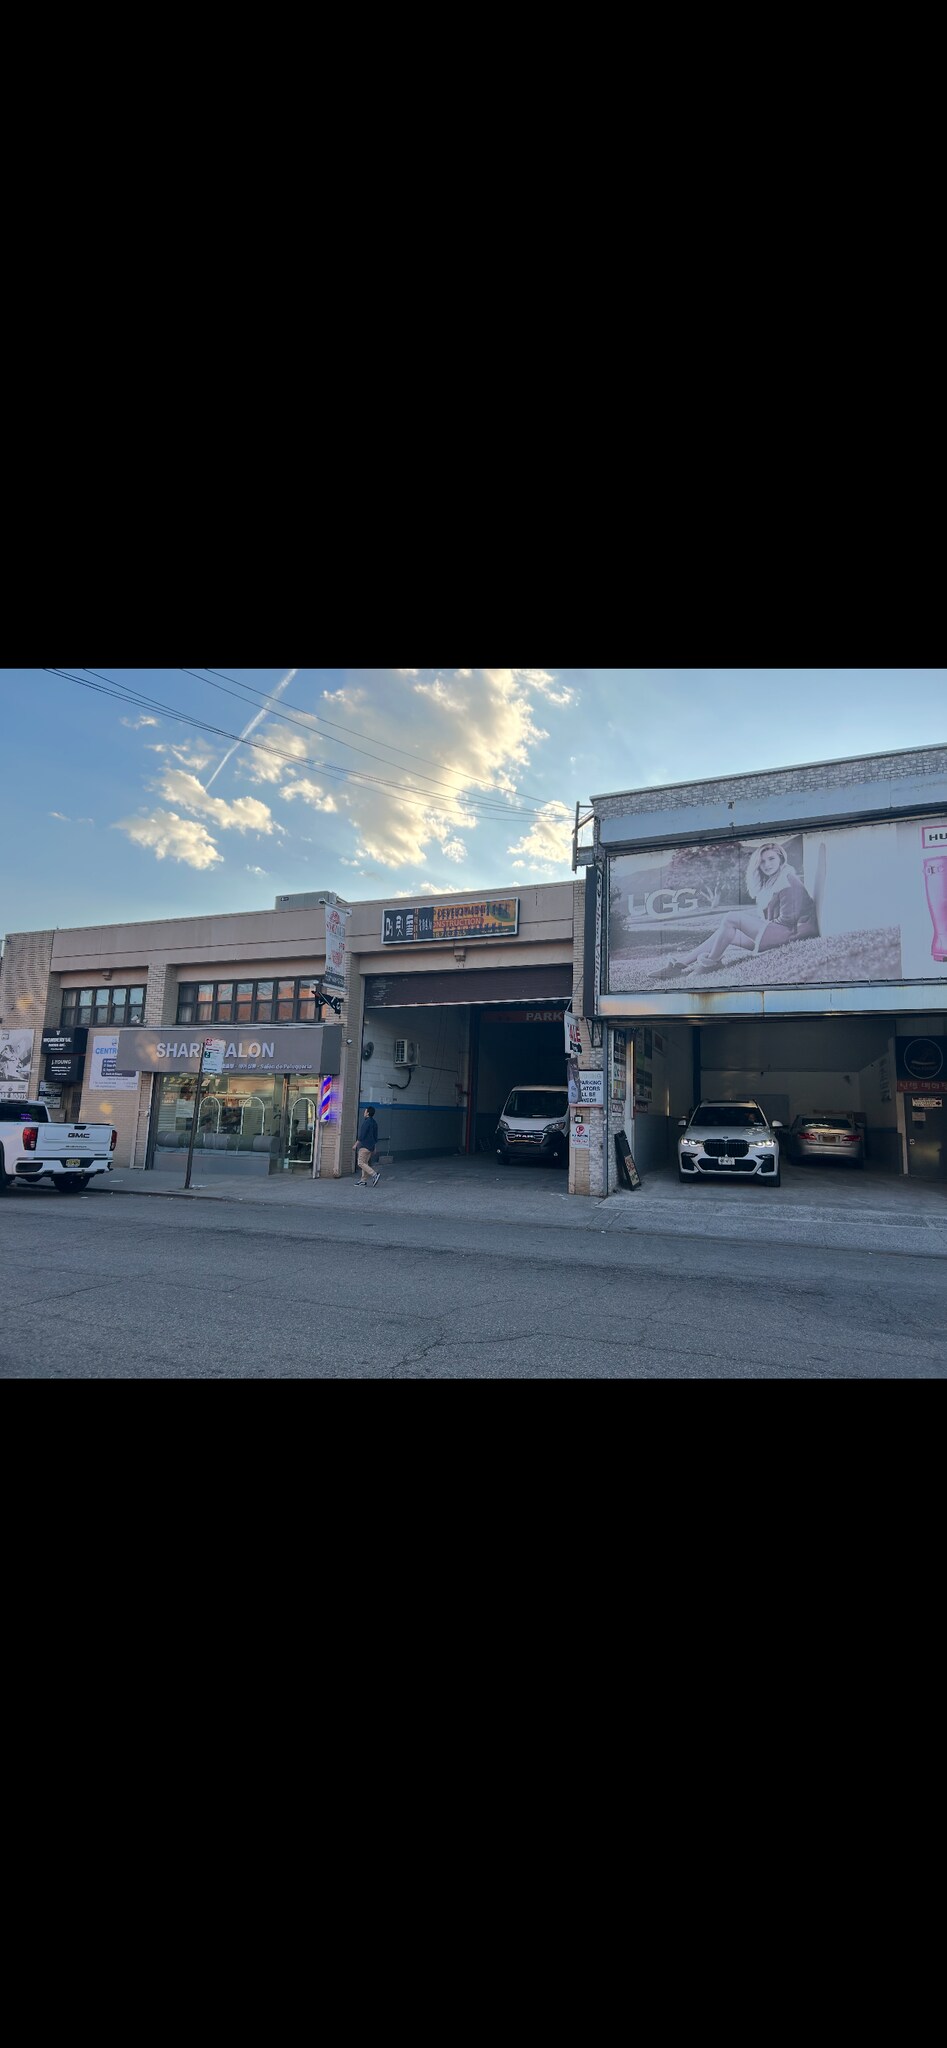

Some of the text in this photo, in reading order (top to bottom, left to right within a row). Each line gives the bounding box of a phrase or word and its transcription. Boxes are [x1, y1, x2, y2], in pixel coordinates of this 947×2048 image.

[628, 888, 698, 919] UGG
[526, 1011, 563, 1021] PARK
[224, 1042, 275, 1058] ALON
